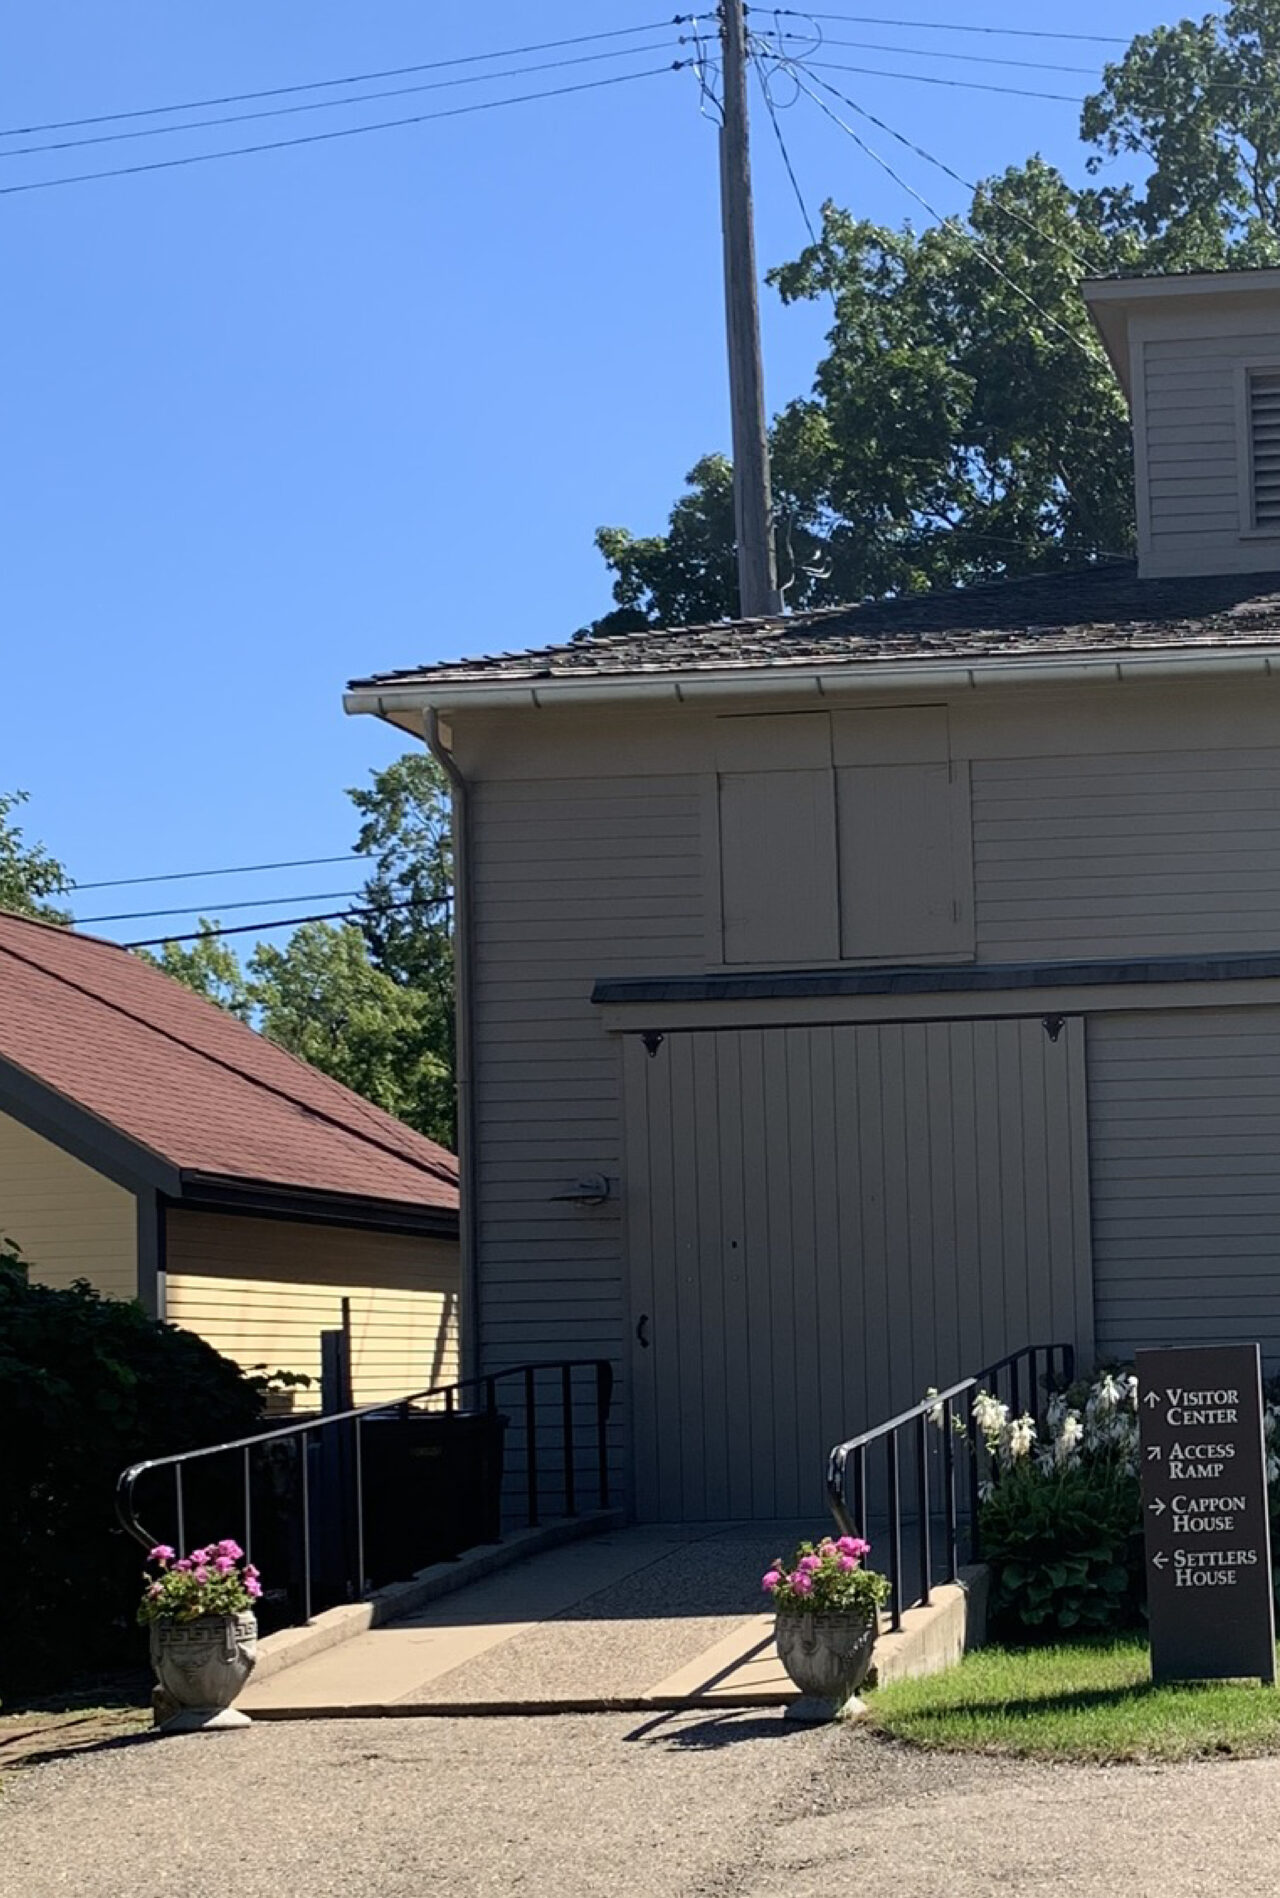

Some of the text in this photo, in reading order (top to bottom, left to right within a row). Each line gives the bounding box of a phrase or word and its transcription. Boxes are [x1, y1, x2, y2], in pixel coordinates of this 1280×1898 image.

[1166, 1388, 1239, 1407] VISITOR
[1166, 1407, 1238, 1425] CENTER
[1169, 1442, 1236, 1460] ACCESS
[1169, 1461, 1224, 1479] RAMP
[1172, 1495, 1246, 1514] CAPPON
[1173, 1515, 1235, 1533] HOUSE
[1173, 1549, 1258, 1568] SETTLERS
[1175, 1568, 1237, 1587] HOUSE
